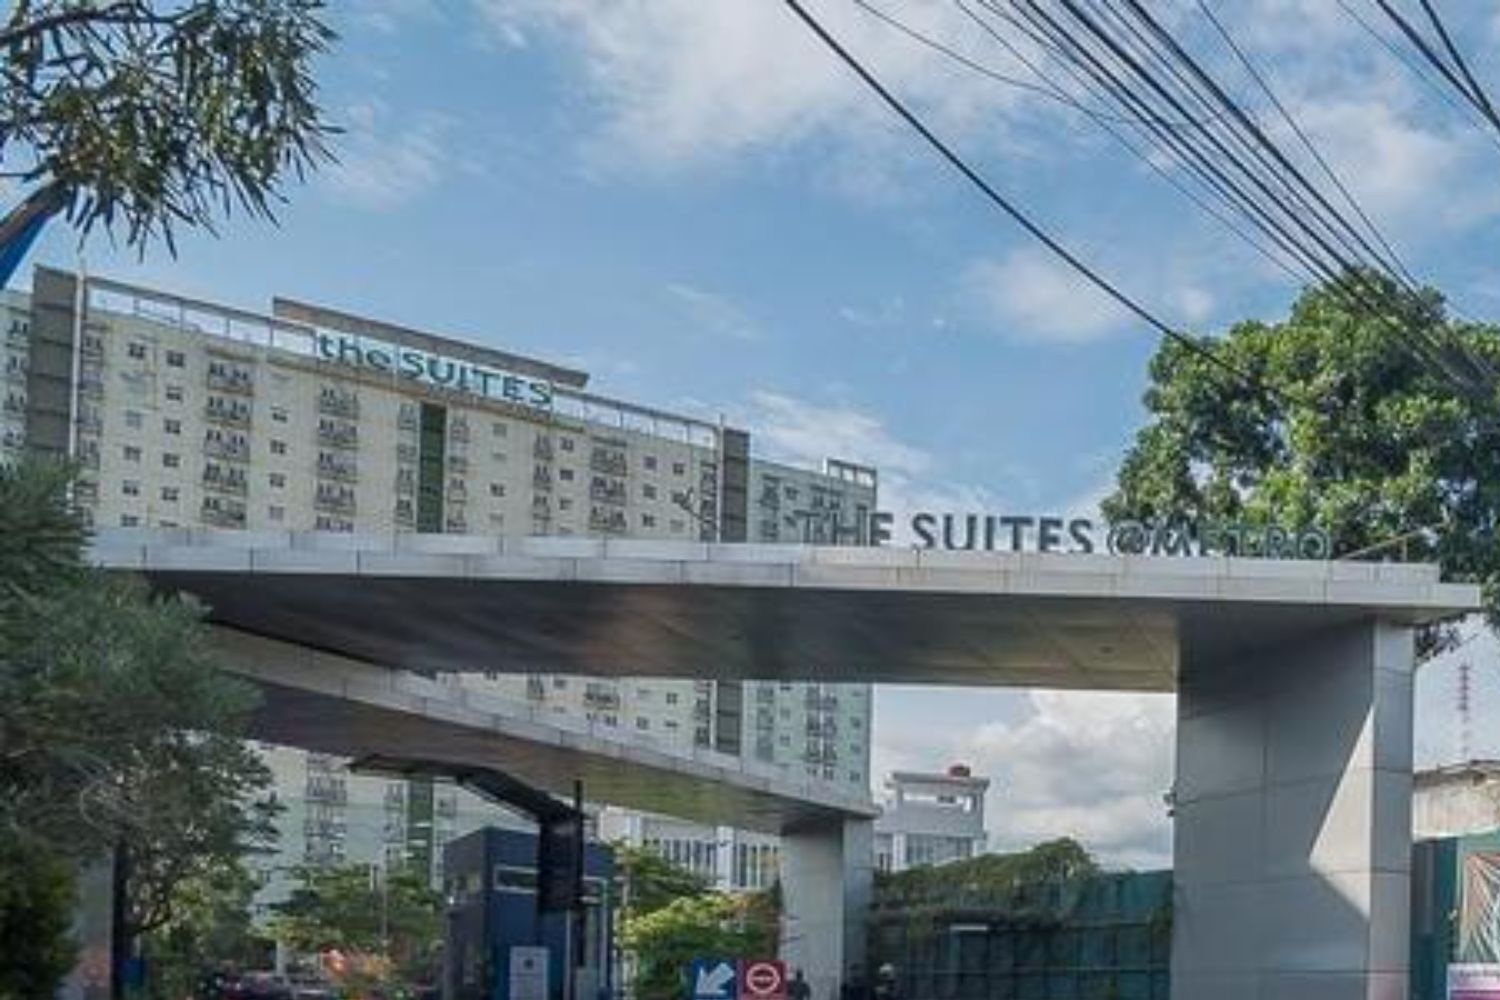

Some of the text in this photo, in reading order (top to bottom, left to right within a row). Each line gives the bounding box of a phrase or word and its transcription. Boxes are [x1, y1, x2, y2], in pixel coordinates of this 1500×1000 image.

[319, 334, 551, 405] the SUITES
[794, 510, 893, 546] THE
[912, 512, 1093, 553] SUITES
